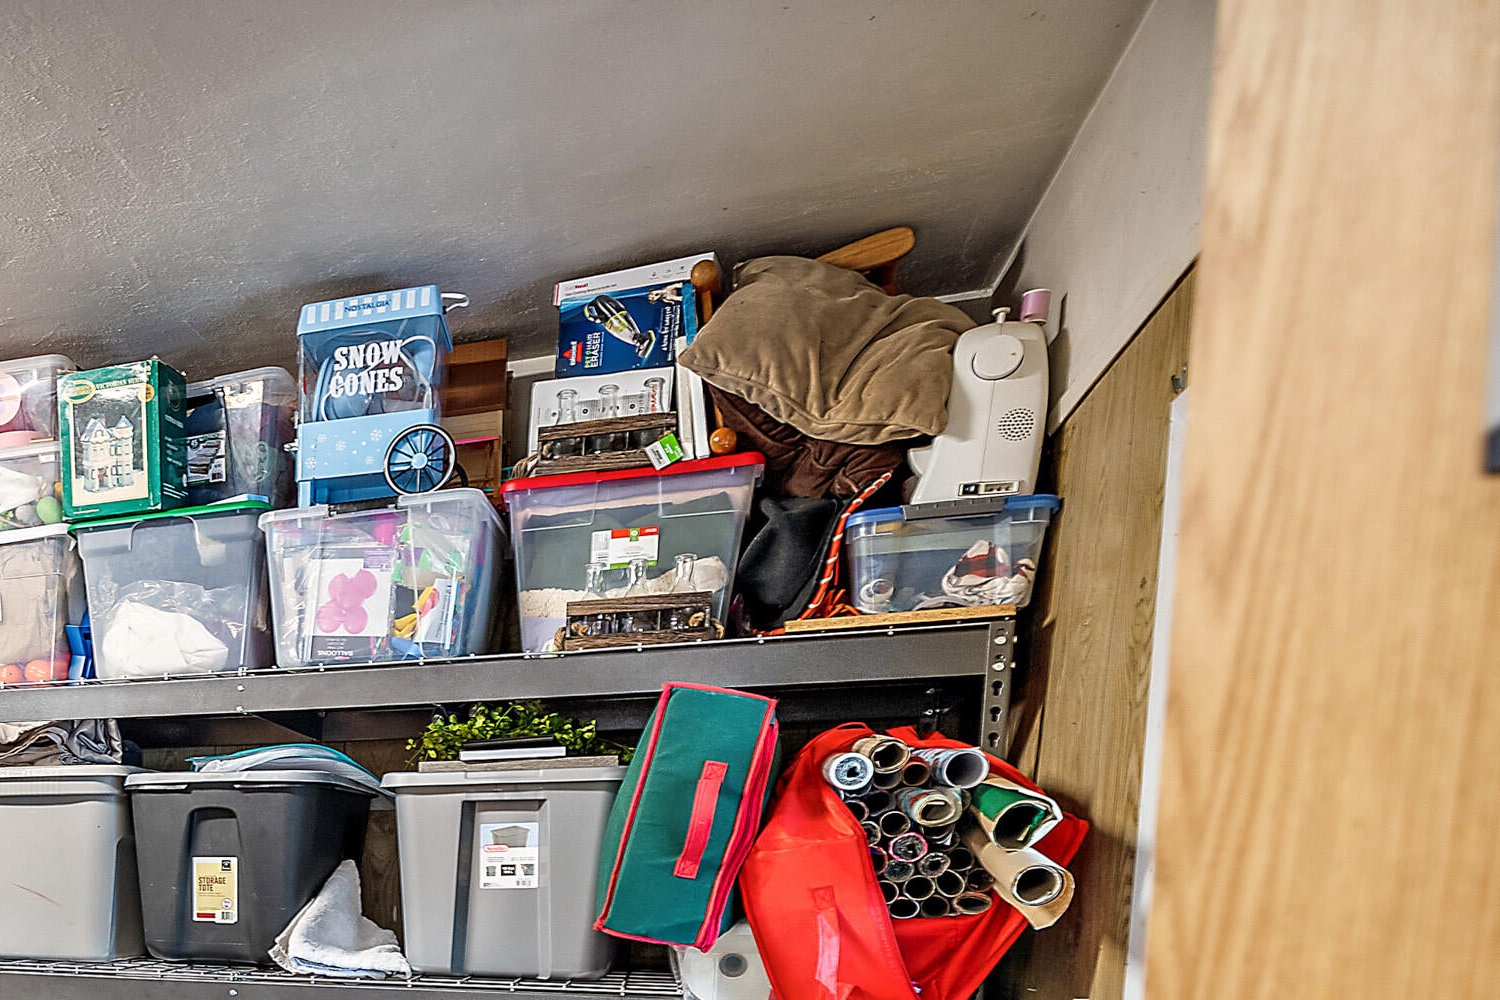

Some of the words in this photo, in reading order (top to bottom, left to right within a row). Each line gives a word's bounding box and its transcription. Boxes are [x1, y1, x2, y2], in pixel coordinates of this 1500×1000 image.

[345, 300, 390, 313] NOSTALGIA
[334, 339, 403, 372] SNOW
[590, 331, 601, 368] ERASER
[329, 367, 404, 398] CONES
[198, 876, 227, 885] STORAGE
